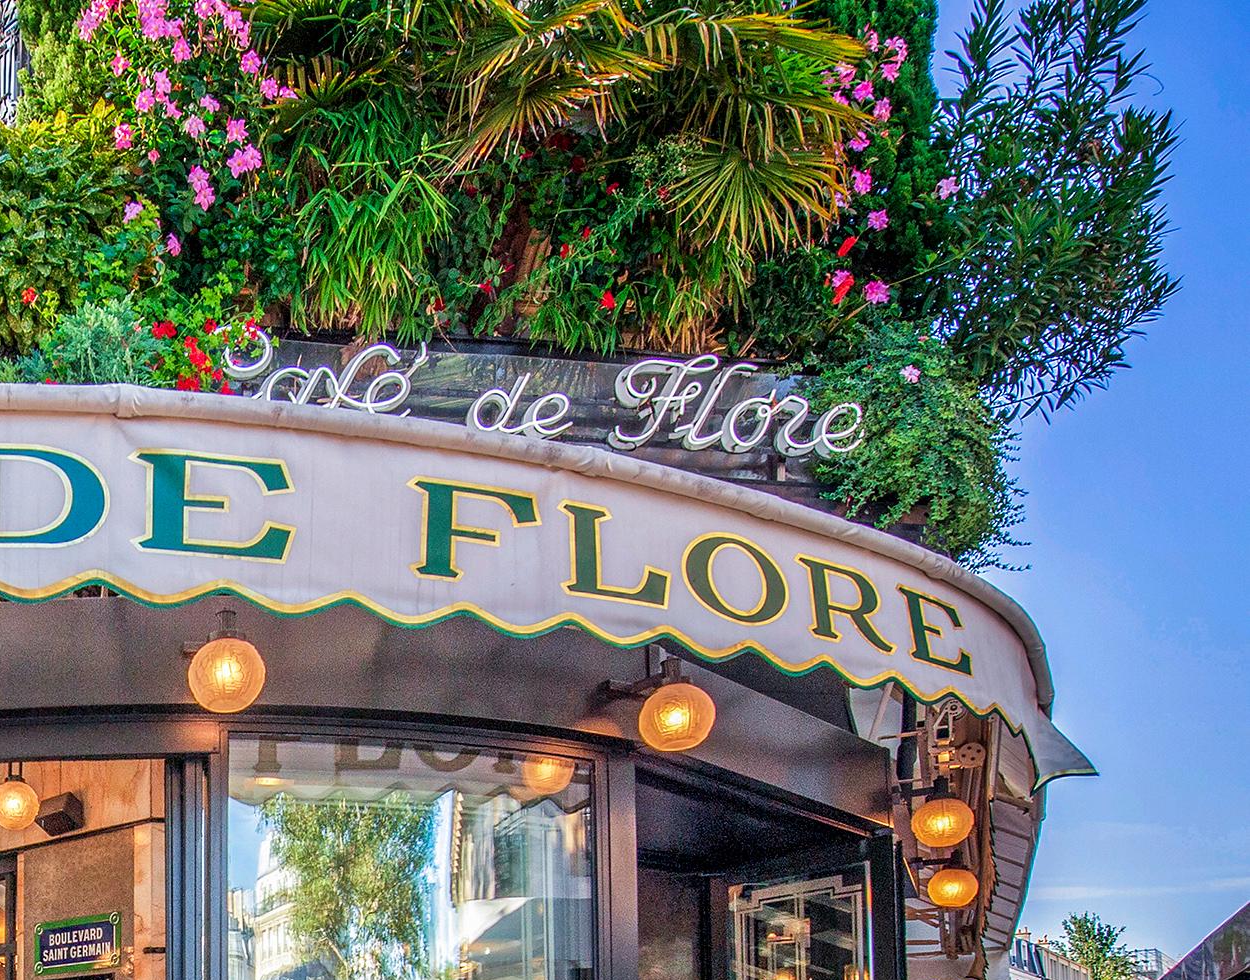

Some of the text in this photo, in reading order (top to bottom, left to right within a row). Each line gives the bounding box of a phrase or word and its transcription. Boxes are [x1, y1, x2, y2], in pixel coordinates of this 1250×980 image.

[466, 373, 573, 438] de
[607, 354, 864, 457] Flore
[406, 475, 974, 679] FLORE
[42, 941, 111, 962] SAINT GERMAIN
[48, 927, 103, 946] BOULEVARD
